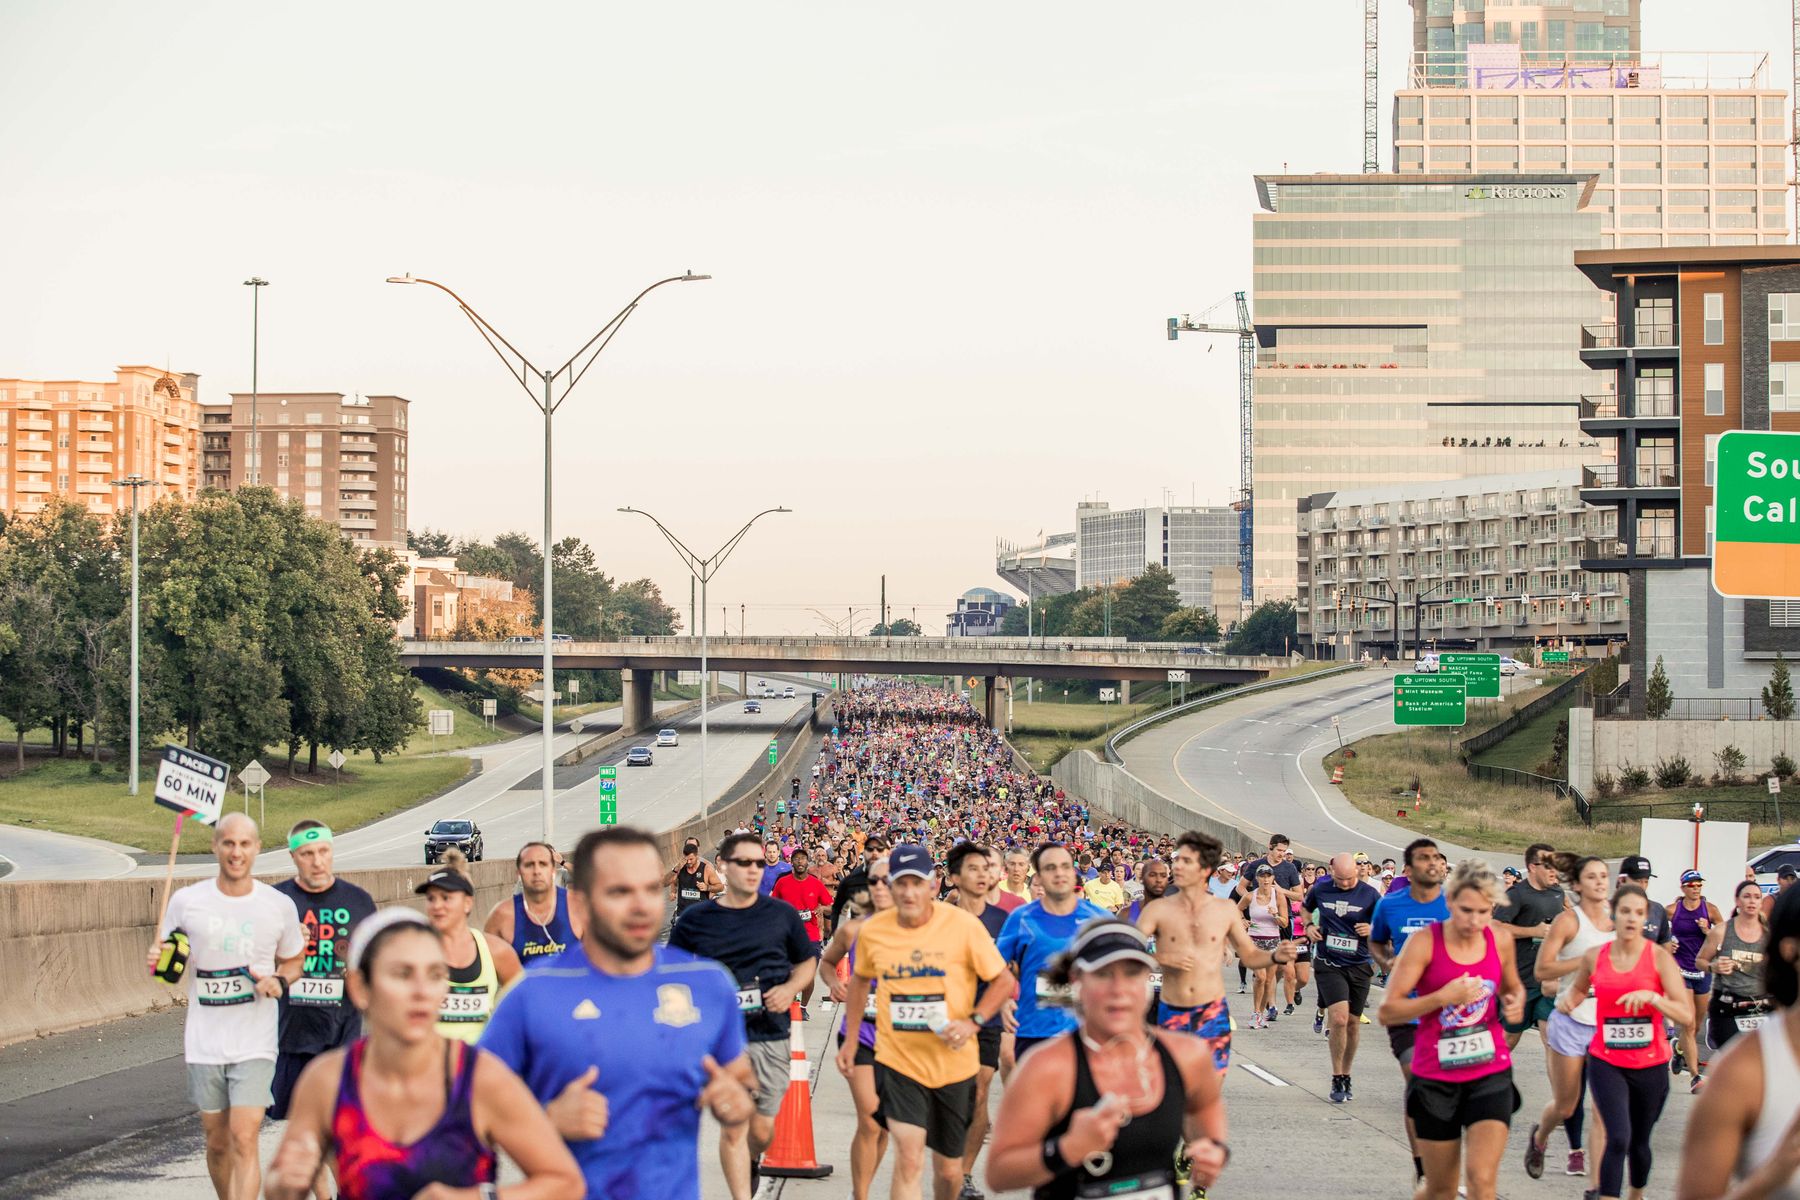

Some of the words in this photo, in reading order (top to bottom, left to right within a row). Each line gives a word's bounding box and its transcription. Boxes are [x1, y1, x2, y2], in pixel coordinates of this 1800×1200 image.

[1743, 495, 1796, 523] Cal
[178, 753, 212, 776] PACER
[163, 775, 183, 792] 60
[186, 783, 217, 806] MIN
[602, 781, 615, 789] 277
[600, 794, 616, 802] MILE
[606, 802, 611, 811] 1
[1332, 937, 1352, 948] 1781
[204, 979, 243, 995] 1275
[301, 981, 334, 995] 1716
[1609, 1025, 1646, 1039] 2836
[1447, 1037, 1485, 1056] 2751
